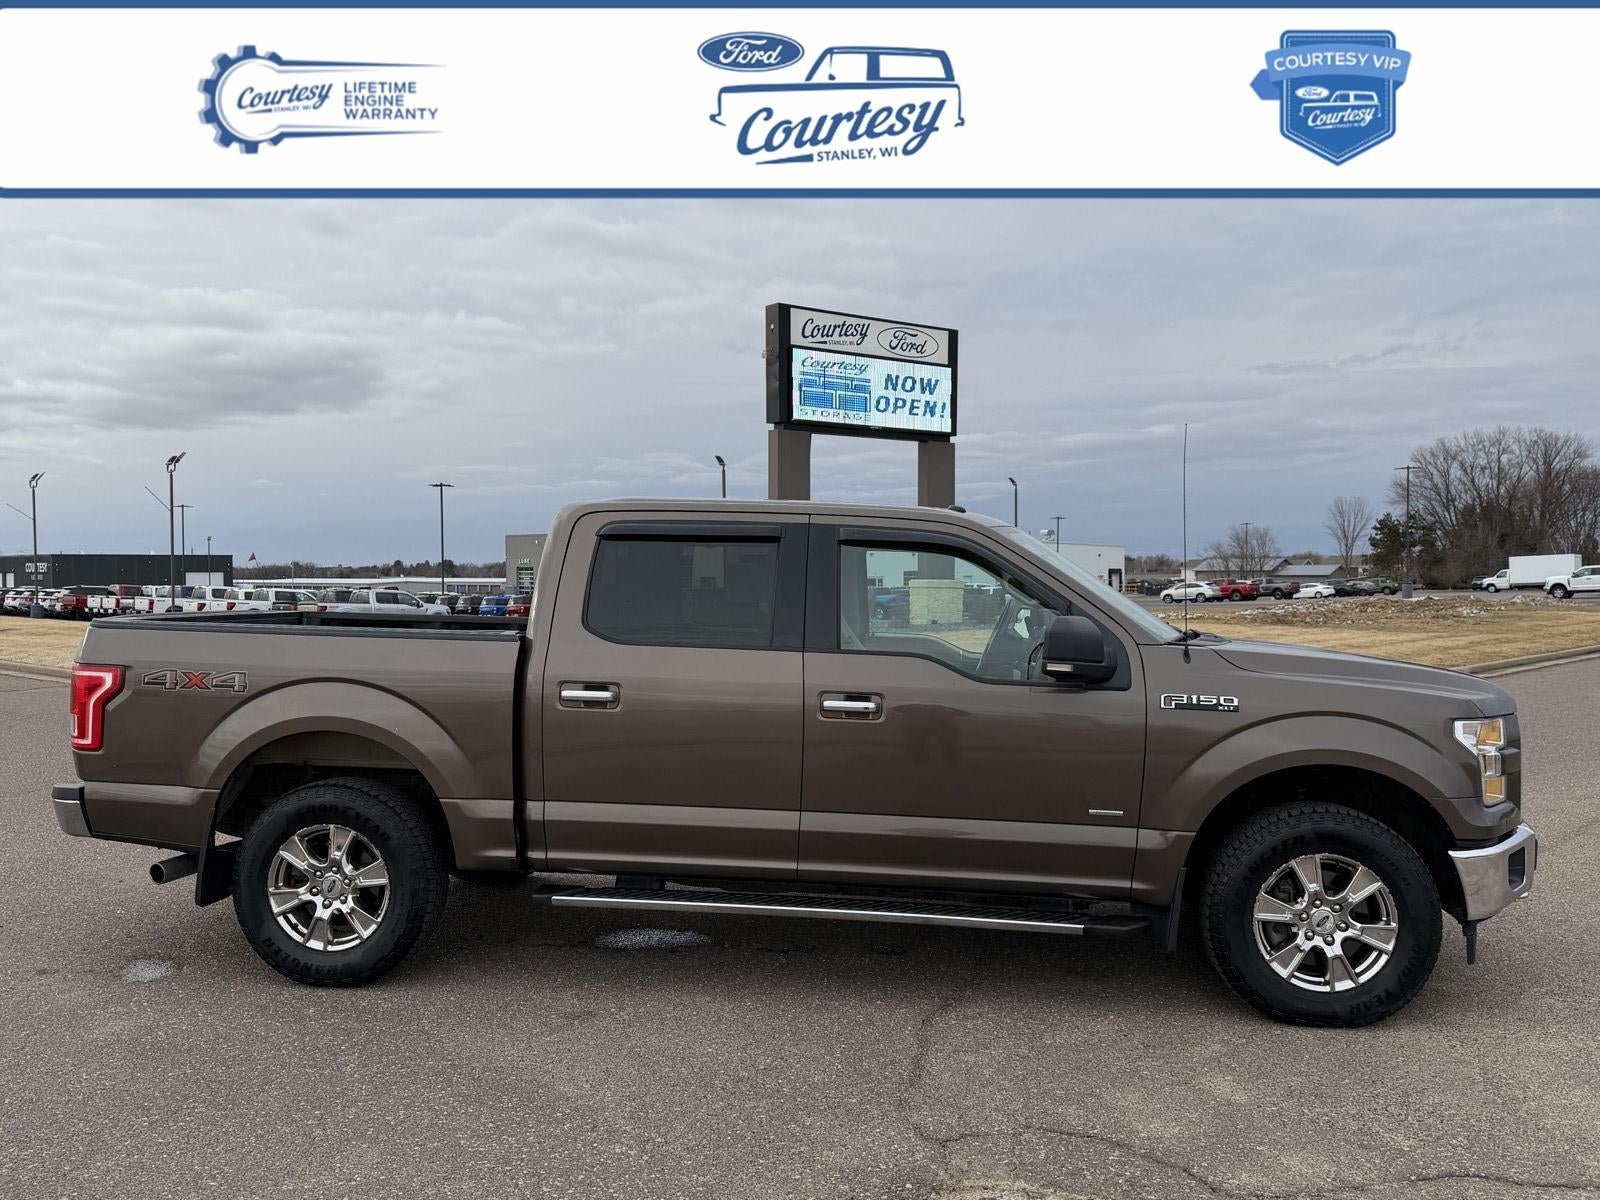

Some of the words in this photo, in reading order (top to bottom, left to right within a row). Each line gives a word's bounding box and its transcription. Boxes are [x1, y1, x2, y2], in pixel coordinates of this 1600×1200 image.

[801, 318, 871, 346] Courtesy
[889, 330, 928, 355] Ford
[801, 356, 869, 375] Courtesy
[884, 373, 941, 395] NOW
[800, 408, 871, 421] STORAGE
[875, 395, 947, 418] OPEN!
[25, 562, 48, 573] COUTESY
